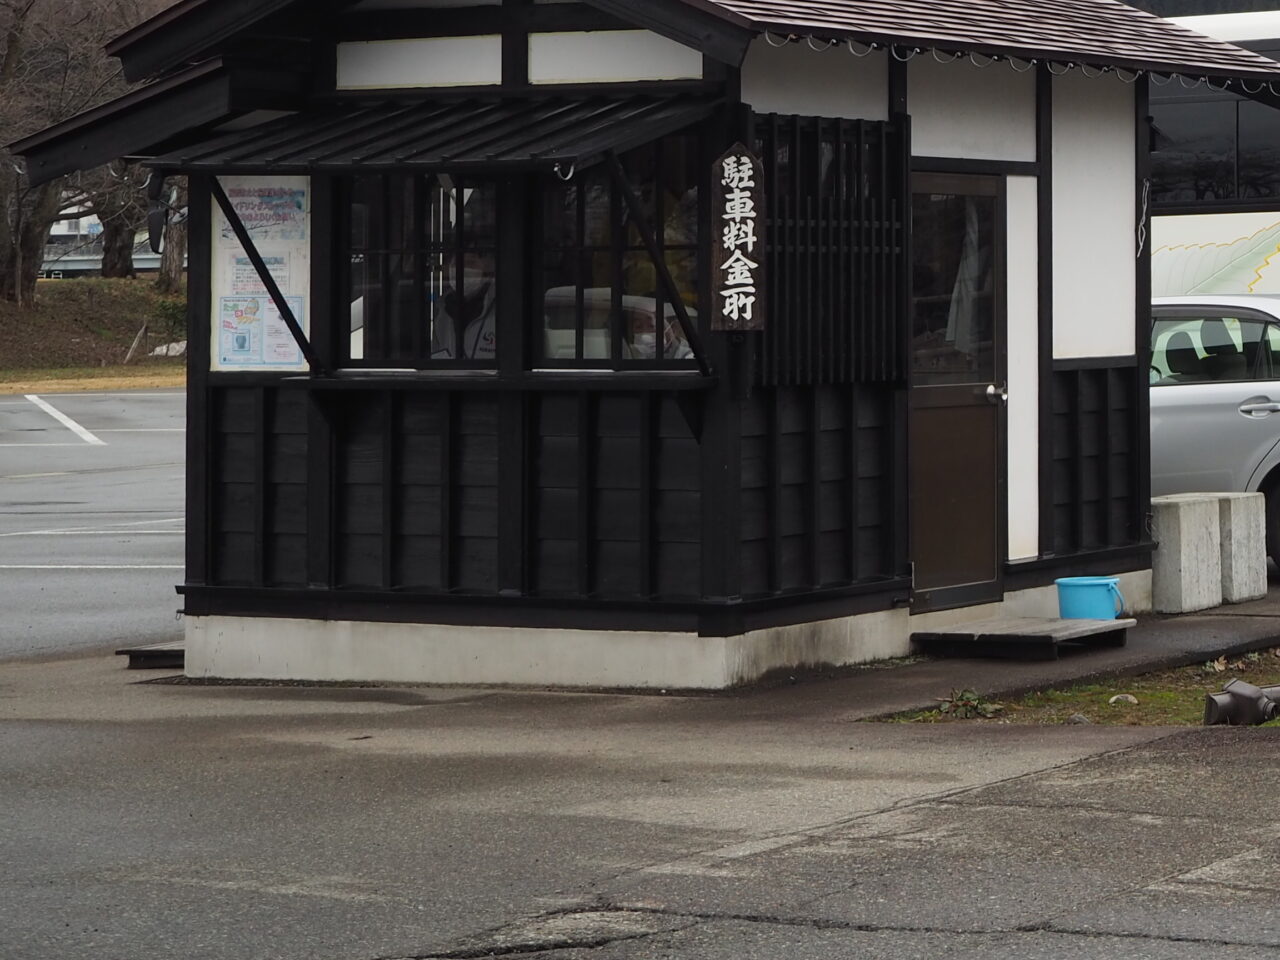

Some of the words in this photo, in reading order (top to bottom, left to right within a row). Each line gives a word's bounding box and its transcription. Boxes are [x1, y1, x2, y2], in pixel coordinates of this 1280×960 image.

[719, 155, 759, 321] 駐車料金所
